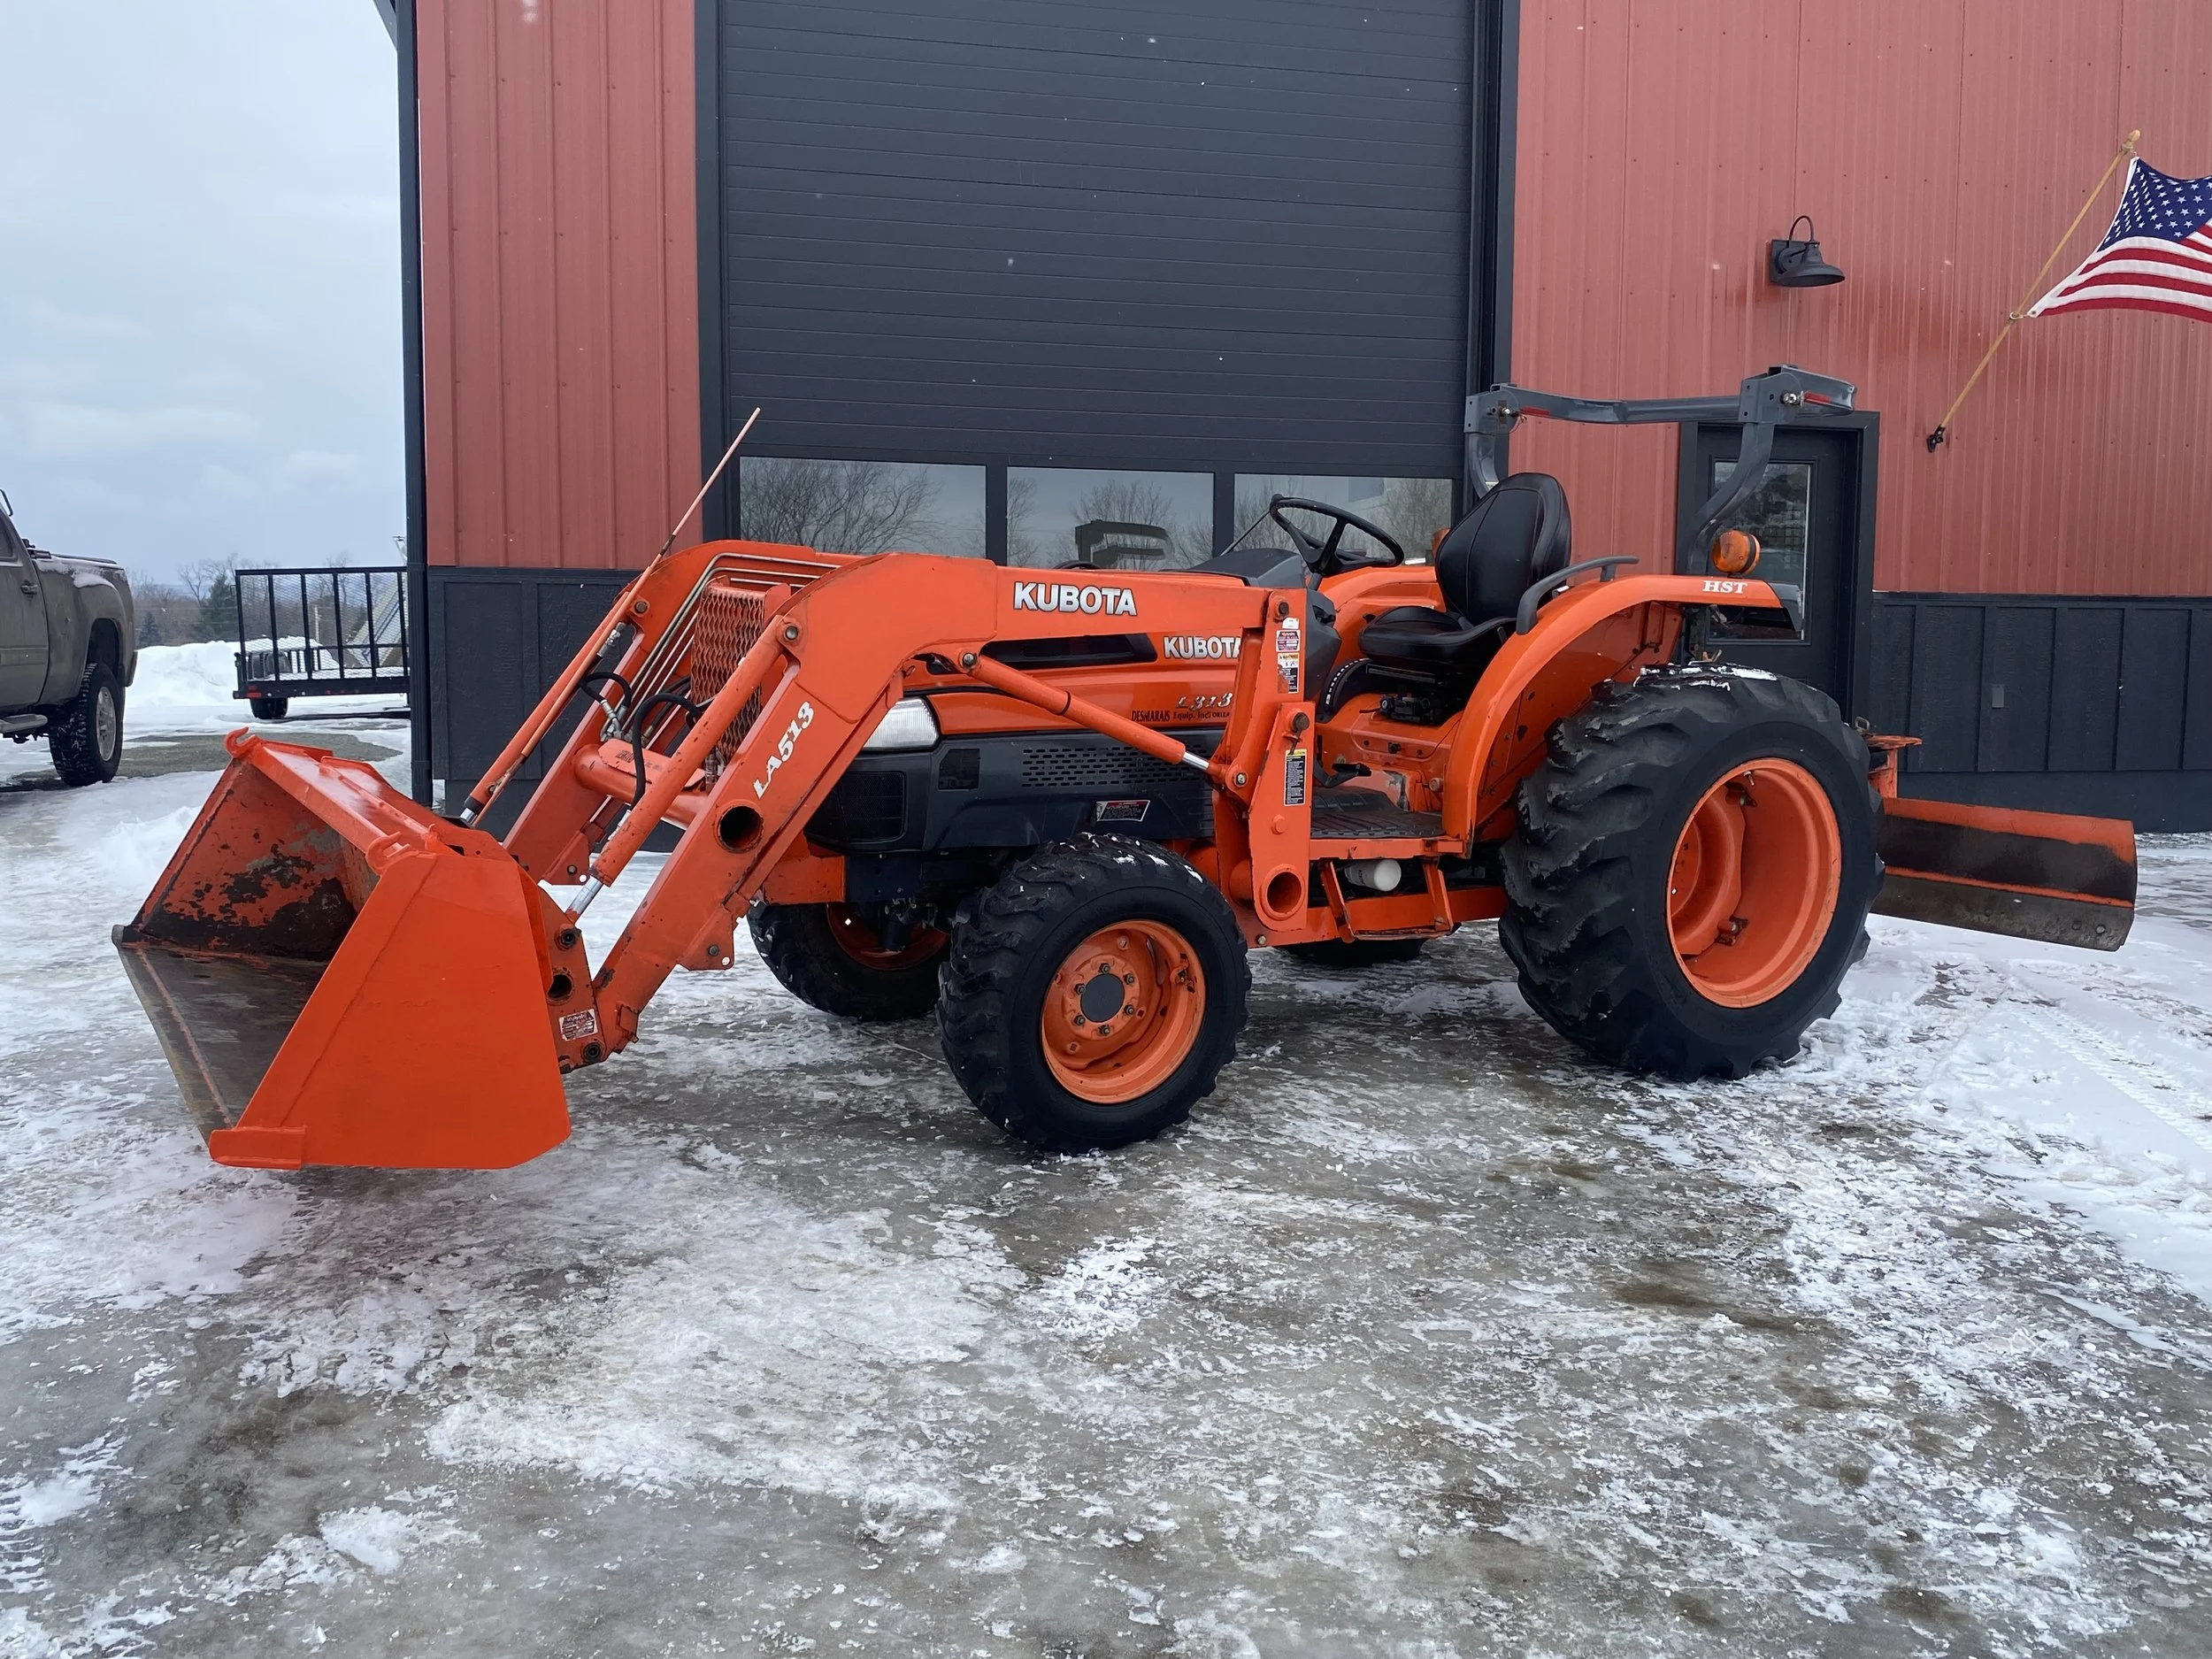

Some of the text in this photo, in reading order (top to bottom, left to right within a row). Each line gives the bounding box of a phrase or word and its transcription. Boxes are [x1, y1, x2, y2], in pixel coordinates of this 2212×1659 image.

[1014, 581, 1138, 617] KUBOTA
[1702, 580, 1747, 594] HST
[1131, 710, 1171, 722] DESMARAIS
[753, 701, 815, 800] LA513
